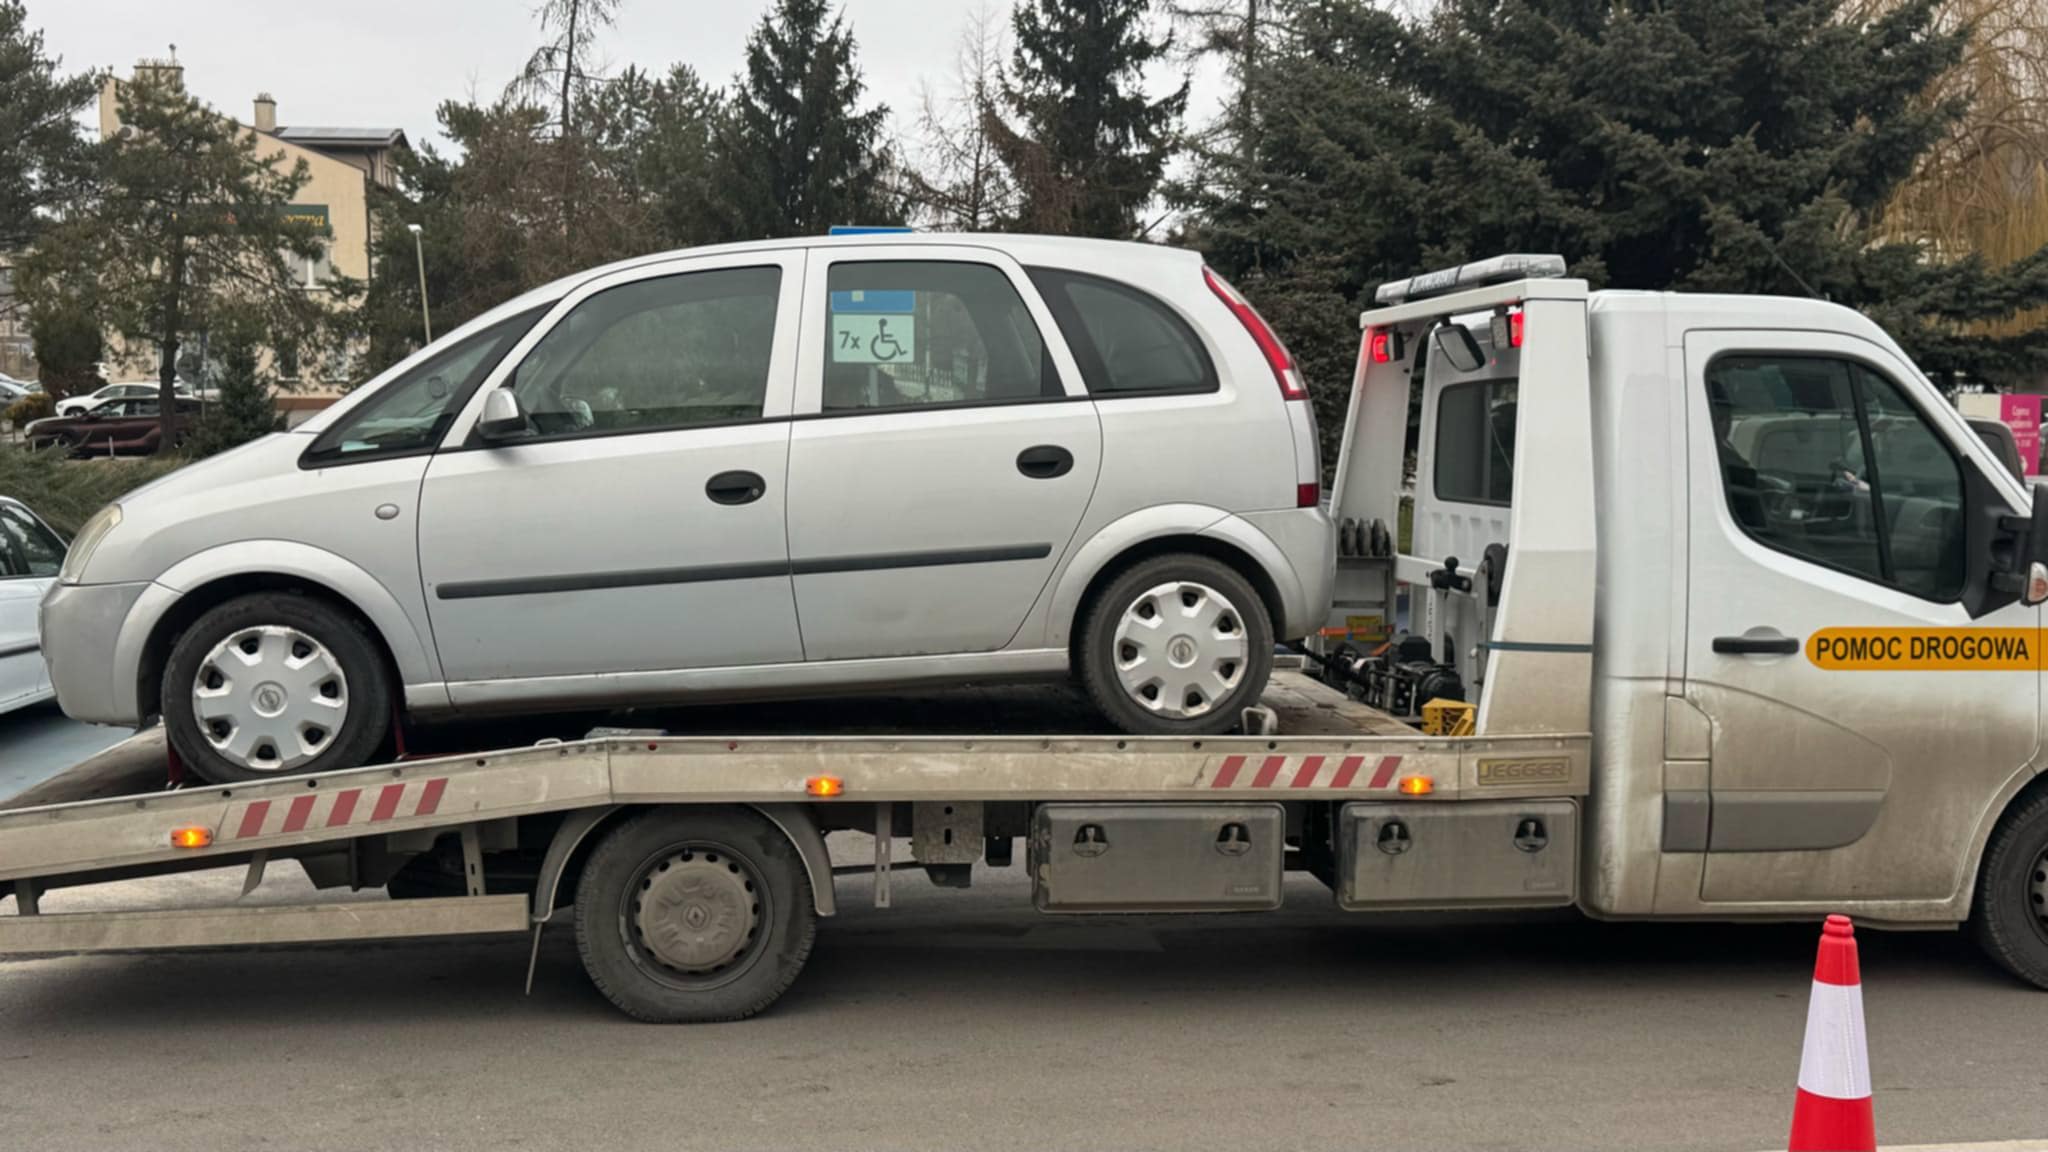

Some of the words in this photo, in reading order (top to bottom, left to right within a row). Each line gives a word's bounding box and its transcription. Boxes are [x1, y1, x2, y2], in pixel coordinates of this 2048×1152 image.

[839, 330, 861, 350] 7x
[1816, 636, 1902, 661] POMOC
[1910, 636, 2029, 660] DROGOWA
[1479, 762, 1568, 779] JEGGER
